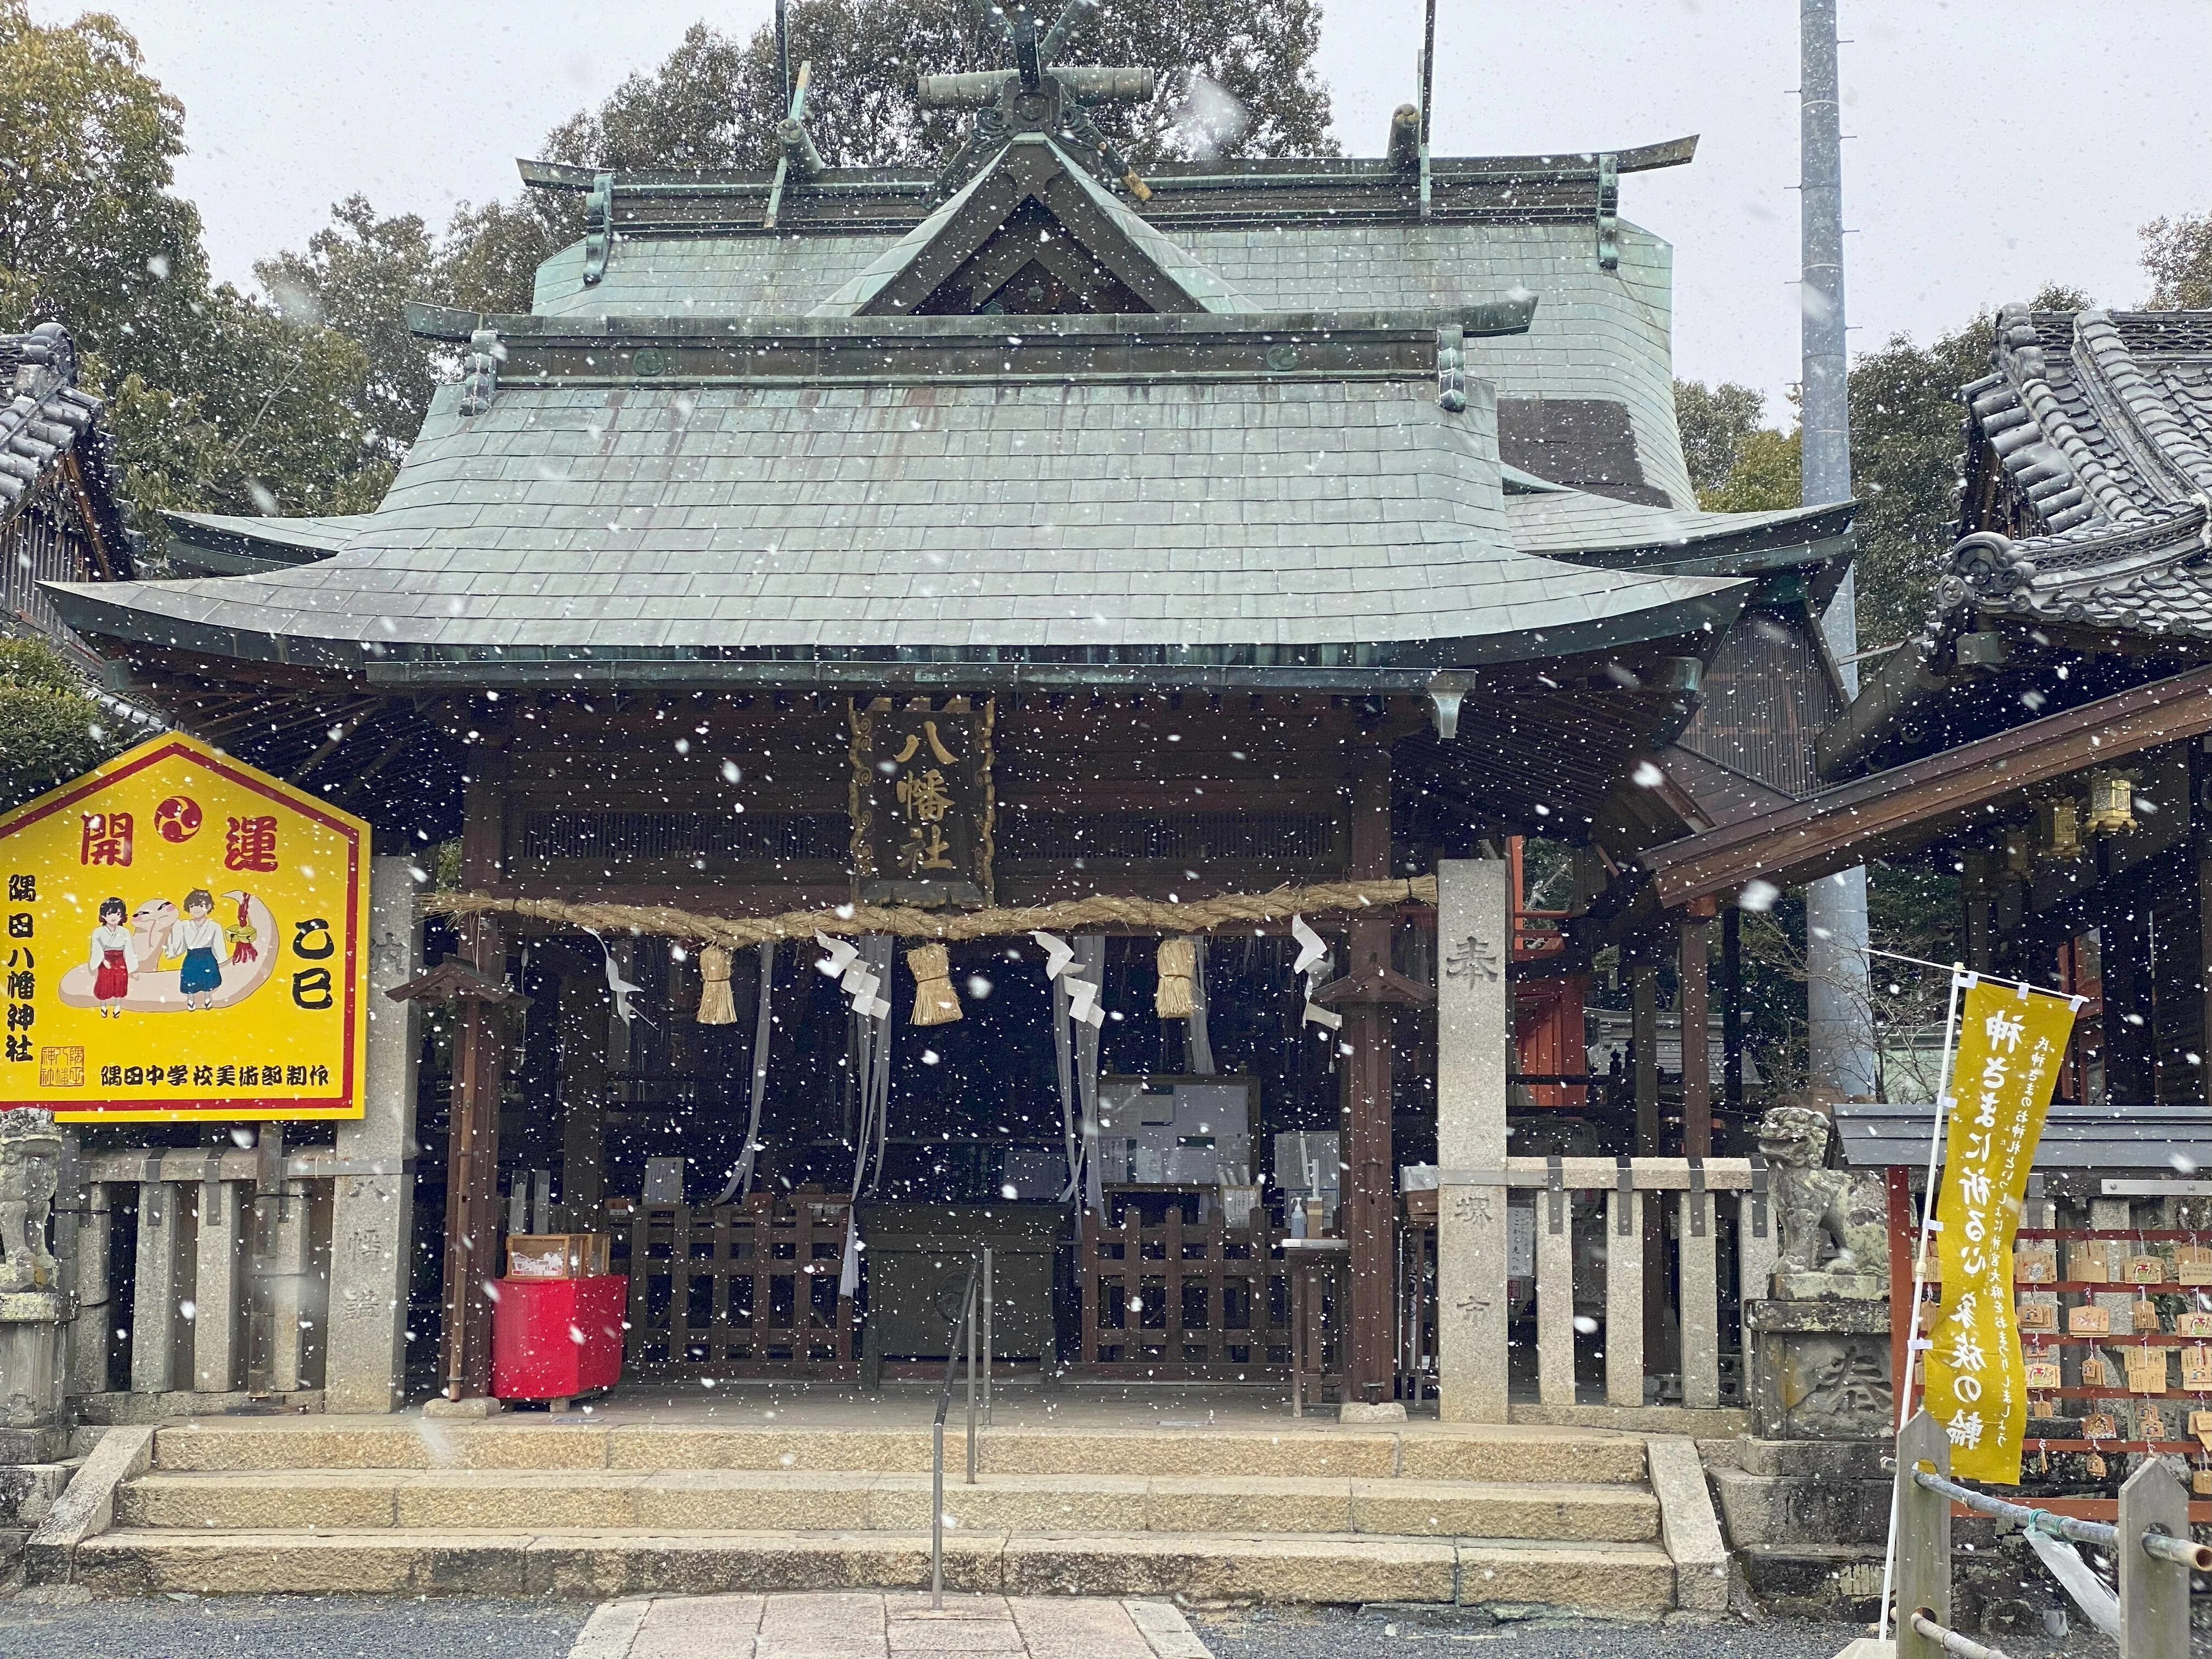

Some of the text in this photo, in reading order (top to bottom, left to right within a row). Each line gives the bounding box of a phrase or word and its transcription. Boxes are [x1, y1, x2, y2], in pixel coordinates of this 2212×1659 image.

[895, 720, 960, 873] 八幡社
[5, 874, 36, 1063] 隅田八幡神社
[1446, 935, 1498, 988] 奉
[100, 1064, 329, 1087] 隅田中学校美術部制作
